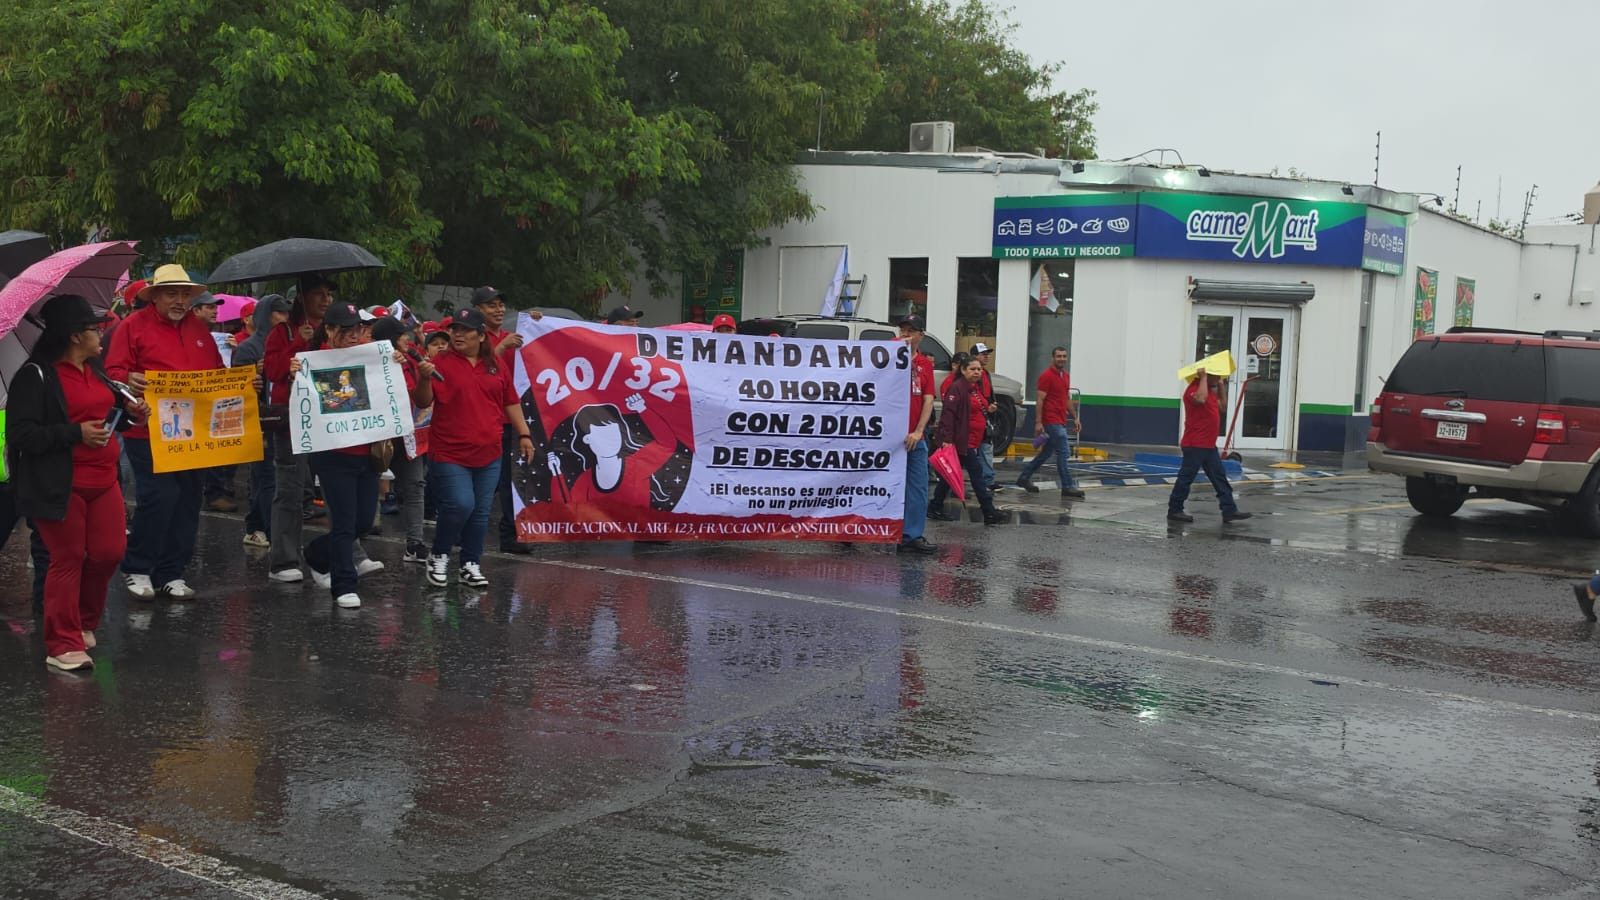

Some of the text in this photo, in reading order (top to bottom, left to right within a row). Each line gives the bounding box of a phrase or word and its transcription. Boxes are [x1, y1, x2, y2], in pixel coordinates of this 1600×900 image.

[1005, 246, 1120, 256] TODO PARA TU NEGOCIO
[377, 343, 391, 355] DE
[637, 333, 909, 370] DEMANDAMOS
[536, 352, 681, 406] 20/32
[382, 356, 403, 435] DESCANSO
[739, 379, 876, 403] 40 HORAS
[296, 380, 313, 452] HORAS
[326, 415, 386, 434] CON 2 DIAS
[727, 412, 883, 437] CON 2 DIAS
[168, 438, 243, 454] POR LA 40 HORAS
[712, 446, 891, 470] DE DESCANSO
[710, 483, 892, 499] ¡El descanso es un derecho,
[748, 496, 853, 511] no un privilegio!
[520, 521, 622, 535] MODIFICACION
[624, 523, 641, 534] AL
[645, 522, 672, 534] ART.
[675, 522, 696, 536] 123,
[699, 522, 767, 534] FRACCION
[781, 521, 893, 536] CONSTITUCIONAL
